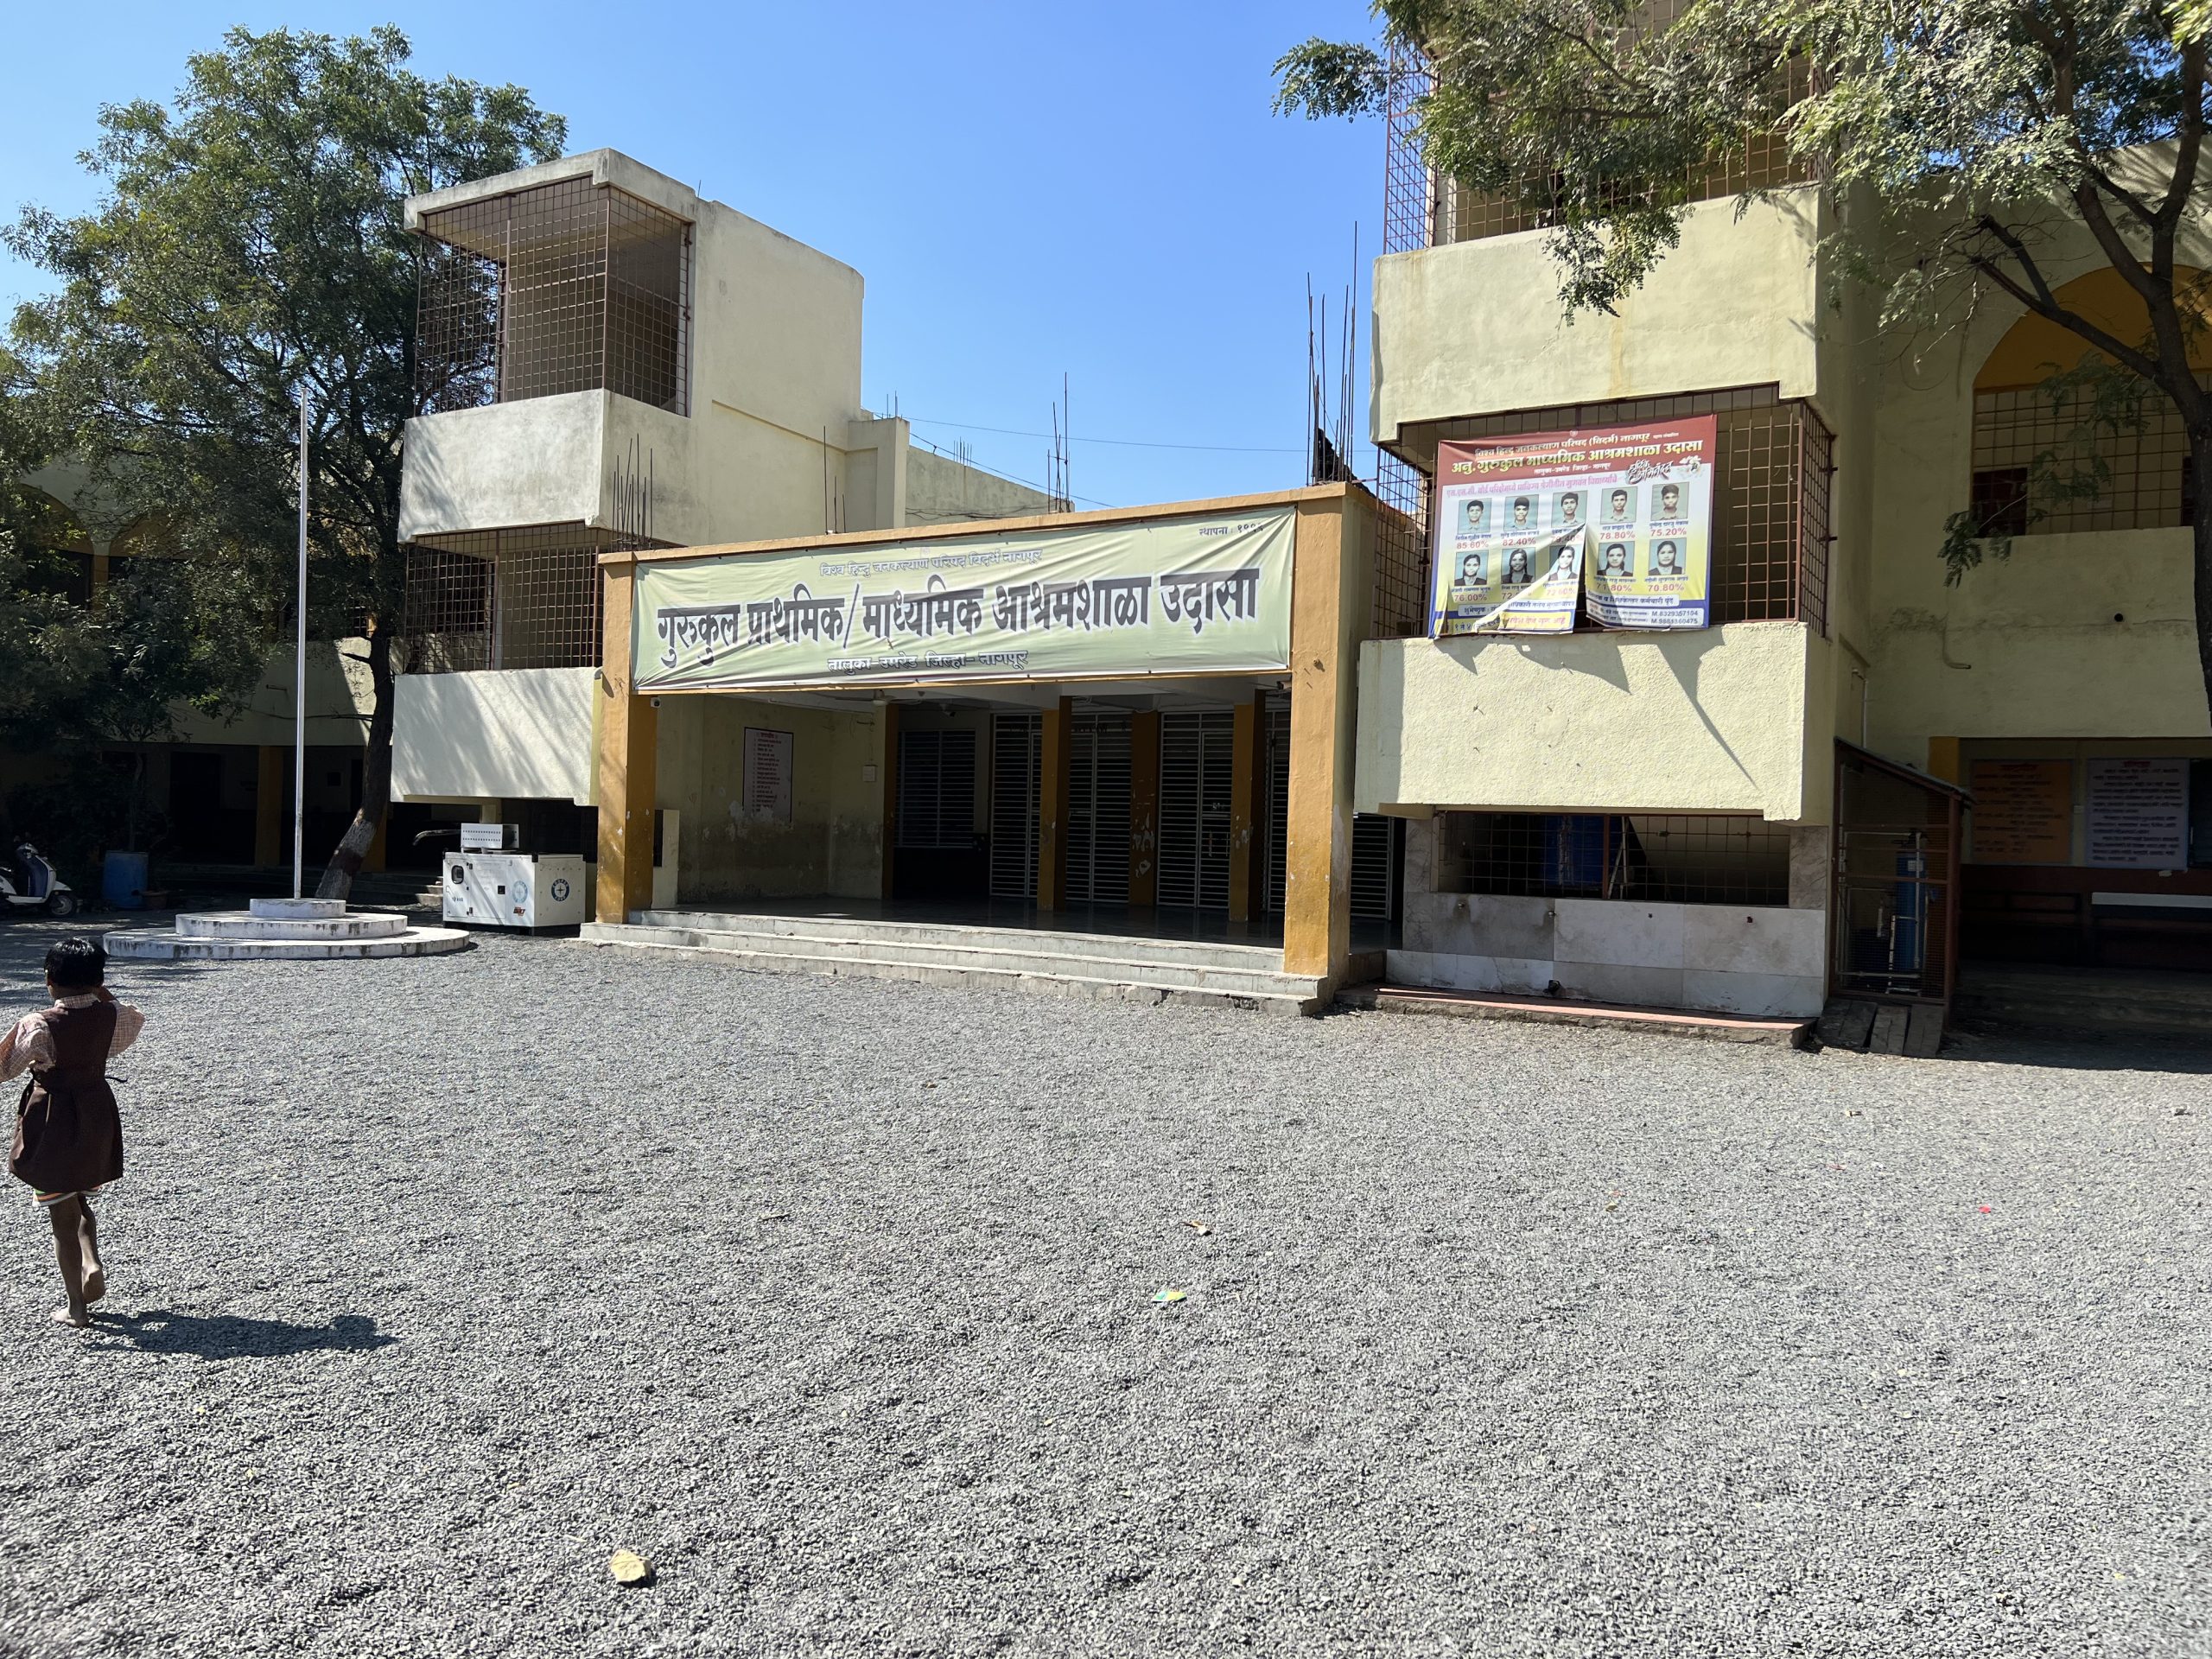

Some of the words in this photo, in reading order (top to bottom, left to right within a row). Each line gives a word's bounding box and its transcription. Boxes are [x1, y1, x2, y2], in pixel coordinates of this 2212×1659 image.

[1516, 442, 1560, 453] जनकल्याण
[1561, 438, 1587, 448] परिषद
[1589, 434, 1618, 447] (विदर्भ)
[1620, 433, 1651, 442] नागपूर
[1477, 455, 1524, 474] गुरुकुल
[1527, 448, 1586, 467] माध्यमिक
[1588, 443, 1662, 461] आश्रमशाळा
[1663, 440, 1703, 454] उदासा
[1198, 526, 1229, 537] स्थापना
[1651, 527, 1687, 537] 75.20%
[1502, 537, 1536, 547] 82.40%
[820, 563, 844, 577] विश्व
[873, 558, 929, 573] जनकल्याण
[969, 548, 1001, 568] विदर्भ
[1003, 549, 1043, 565] नागपूर
[1454, 593, 1487, 602] 76.00%
[658, 604, 741, 669] गुरुकुल
[862, 574, 984, 638] माध्यमिक
[993, 576, 1152, 632] आश्रमशाळा
[1160, 568, 1260, 634] उदासा
[978, 651, 1029, 671] नागपूर
